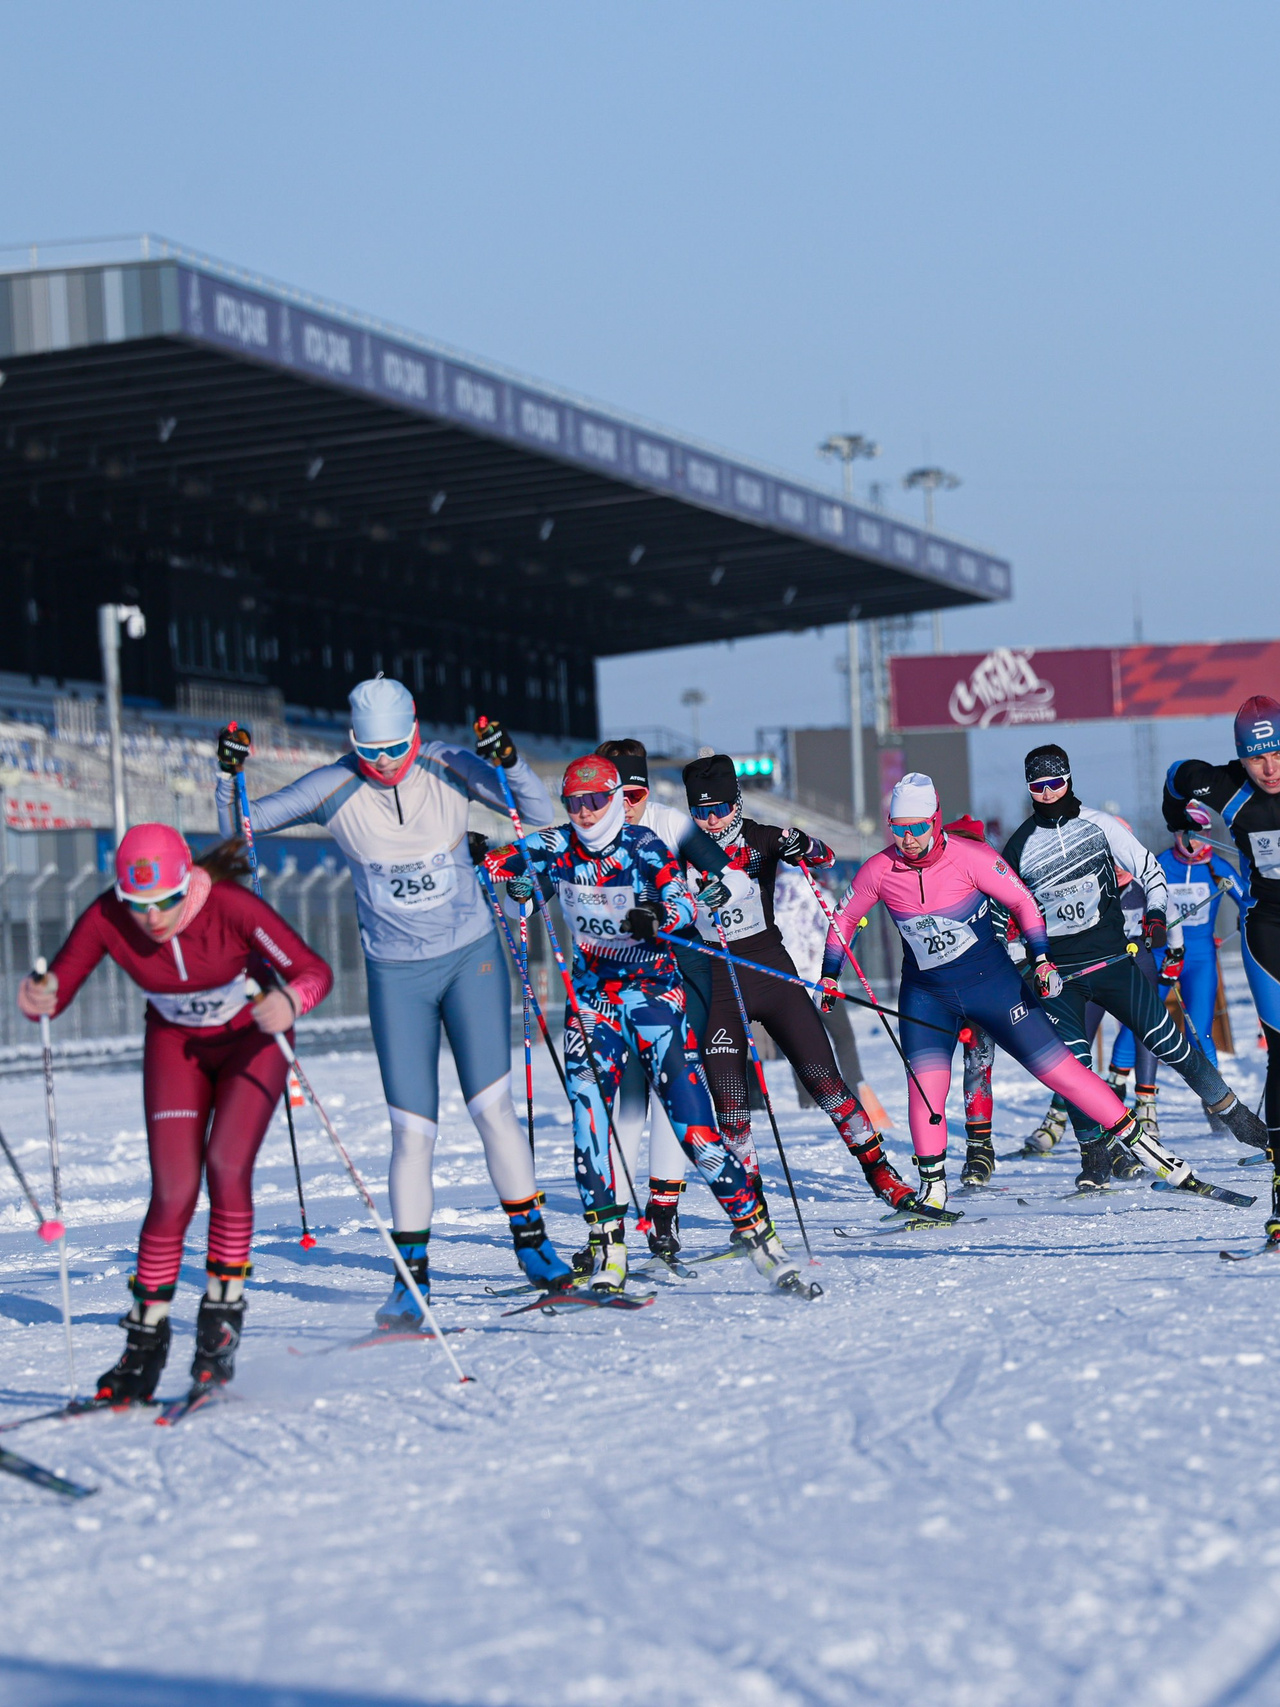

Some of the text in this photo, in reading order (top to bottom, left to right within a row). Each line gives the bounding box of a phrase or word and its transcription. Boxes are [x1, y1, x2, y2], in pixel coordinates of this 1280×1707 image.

[390, 874, 436, 898] 258
[1056, 901, 1085, 921] 496
[576, 916, 616, 935] 266
[923, 930, 956, 955] 283
[705, 1046, 739, 1055] Löffler
